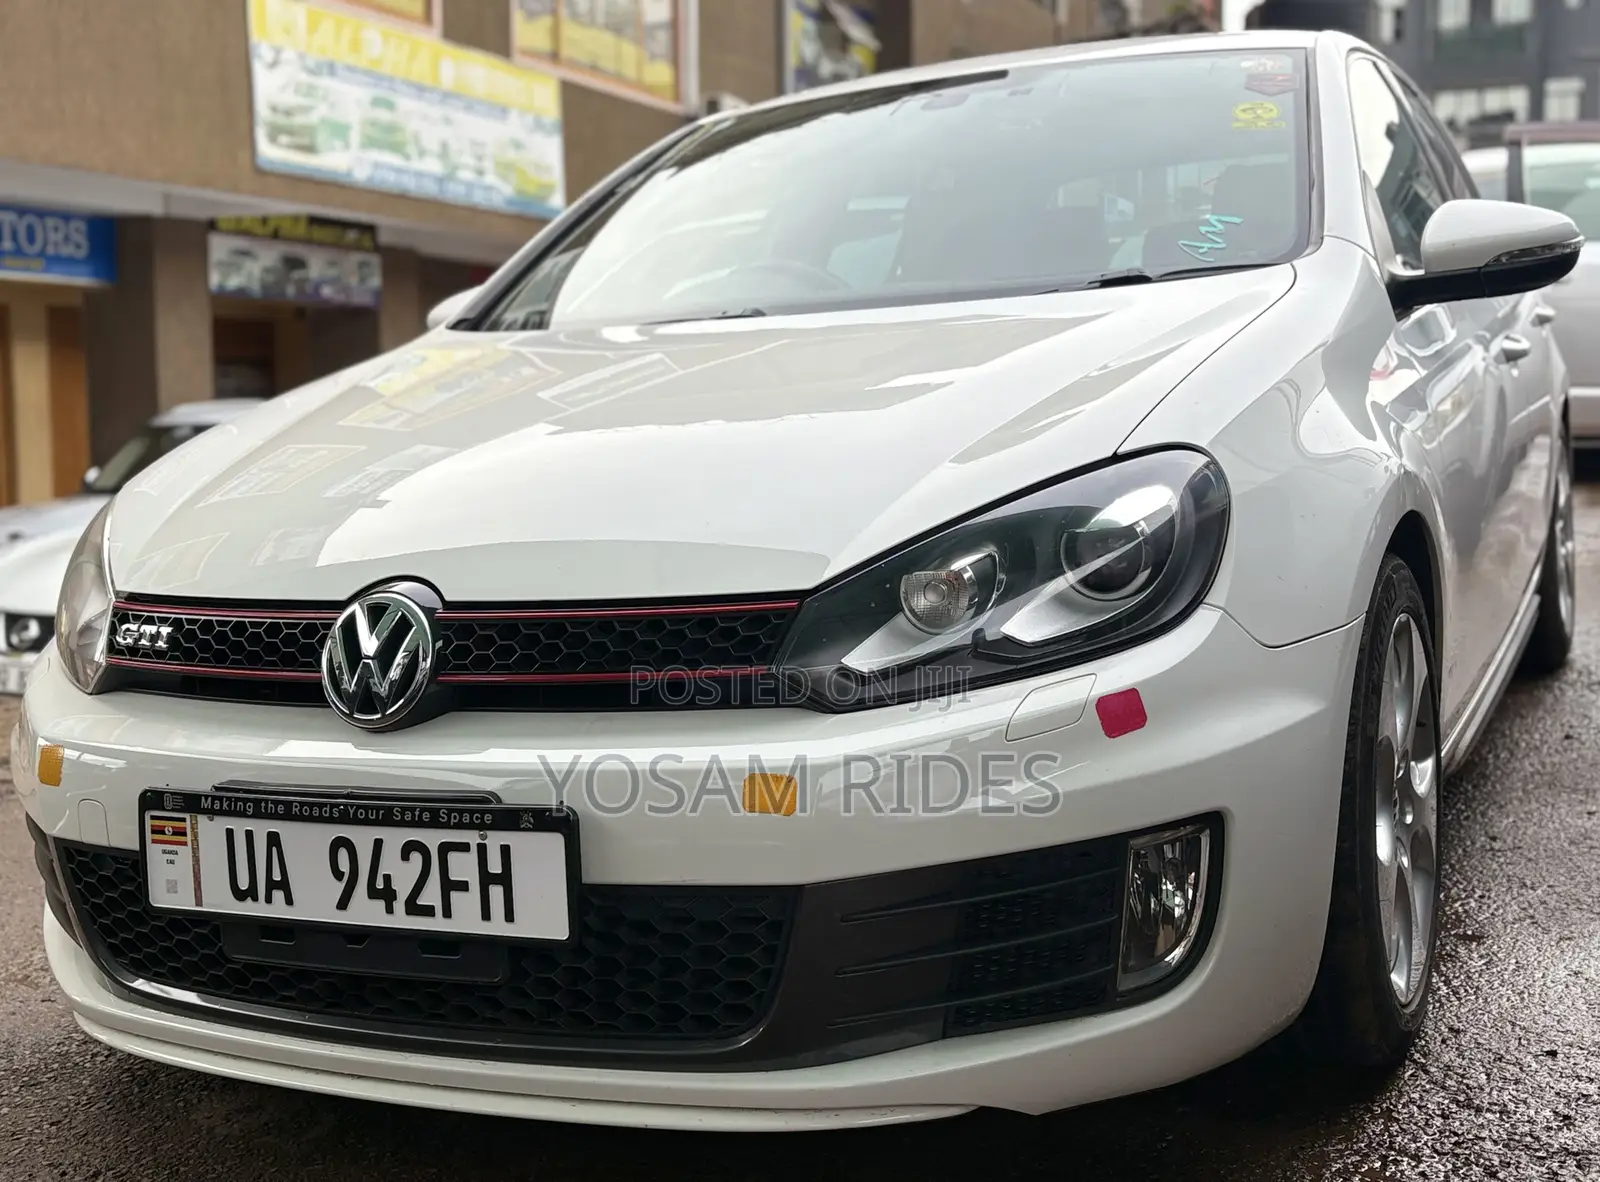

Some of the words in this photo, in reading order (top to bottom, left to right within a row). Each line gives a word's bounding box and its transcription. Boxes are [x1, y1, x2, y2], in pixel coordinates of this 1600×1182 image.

[115, 623, 173, 650] GTI
[200, 796, 254, 814] Making
[261, 800, 285, 814] the
[292, 802, 340, 818] Roads
[348, 805, 385, 821] Your
[392, 807, 431, 822] Safe
[439, 808, 494, 826] Space
[225, 826, 294, 906] UA
[328, 834, 516, 923] 942FH
